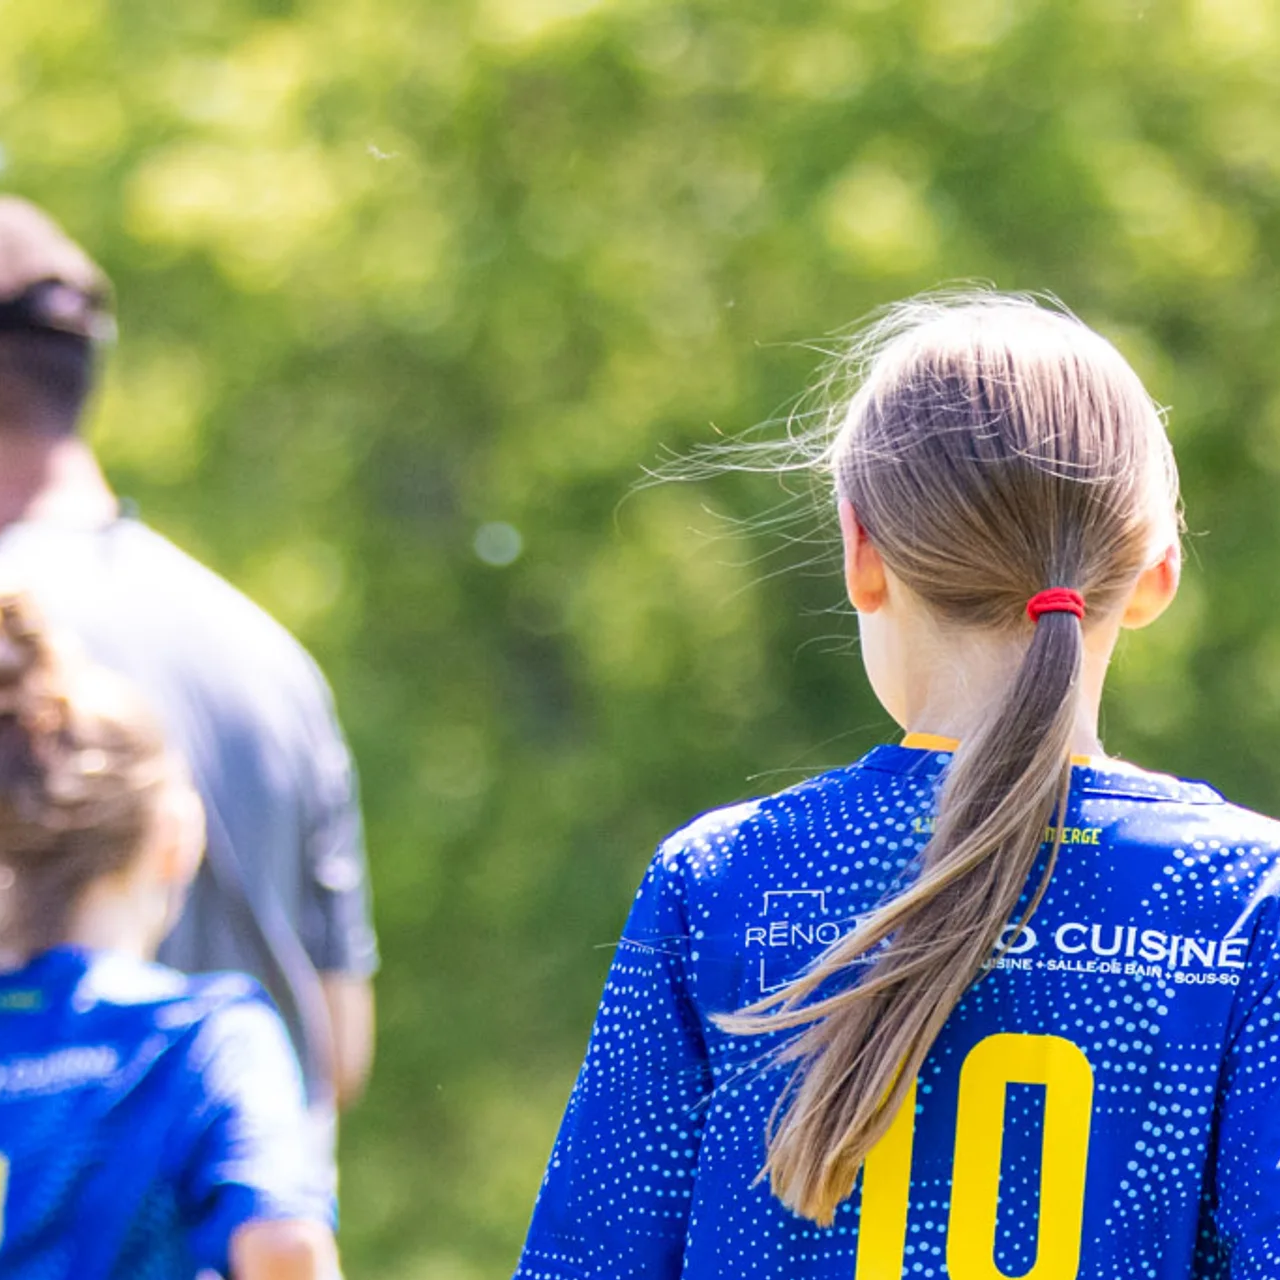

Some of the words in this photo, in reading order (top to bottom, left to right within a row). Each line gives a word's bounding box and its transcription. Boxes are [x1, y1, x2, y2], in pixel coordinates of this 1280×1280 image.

[1054, 922, 1249, 969] CUISINE
[1047, 959, 1097, 973] SALLE
[1124, 963, 1162, 978] BAIN
[1174, 972, 1241, 986] SOUS-SO
